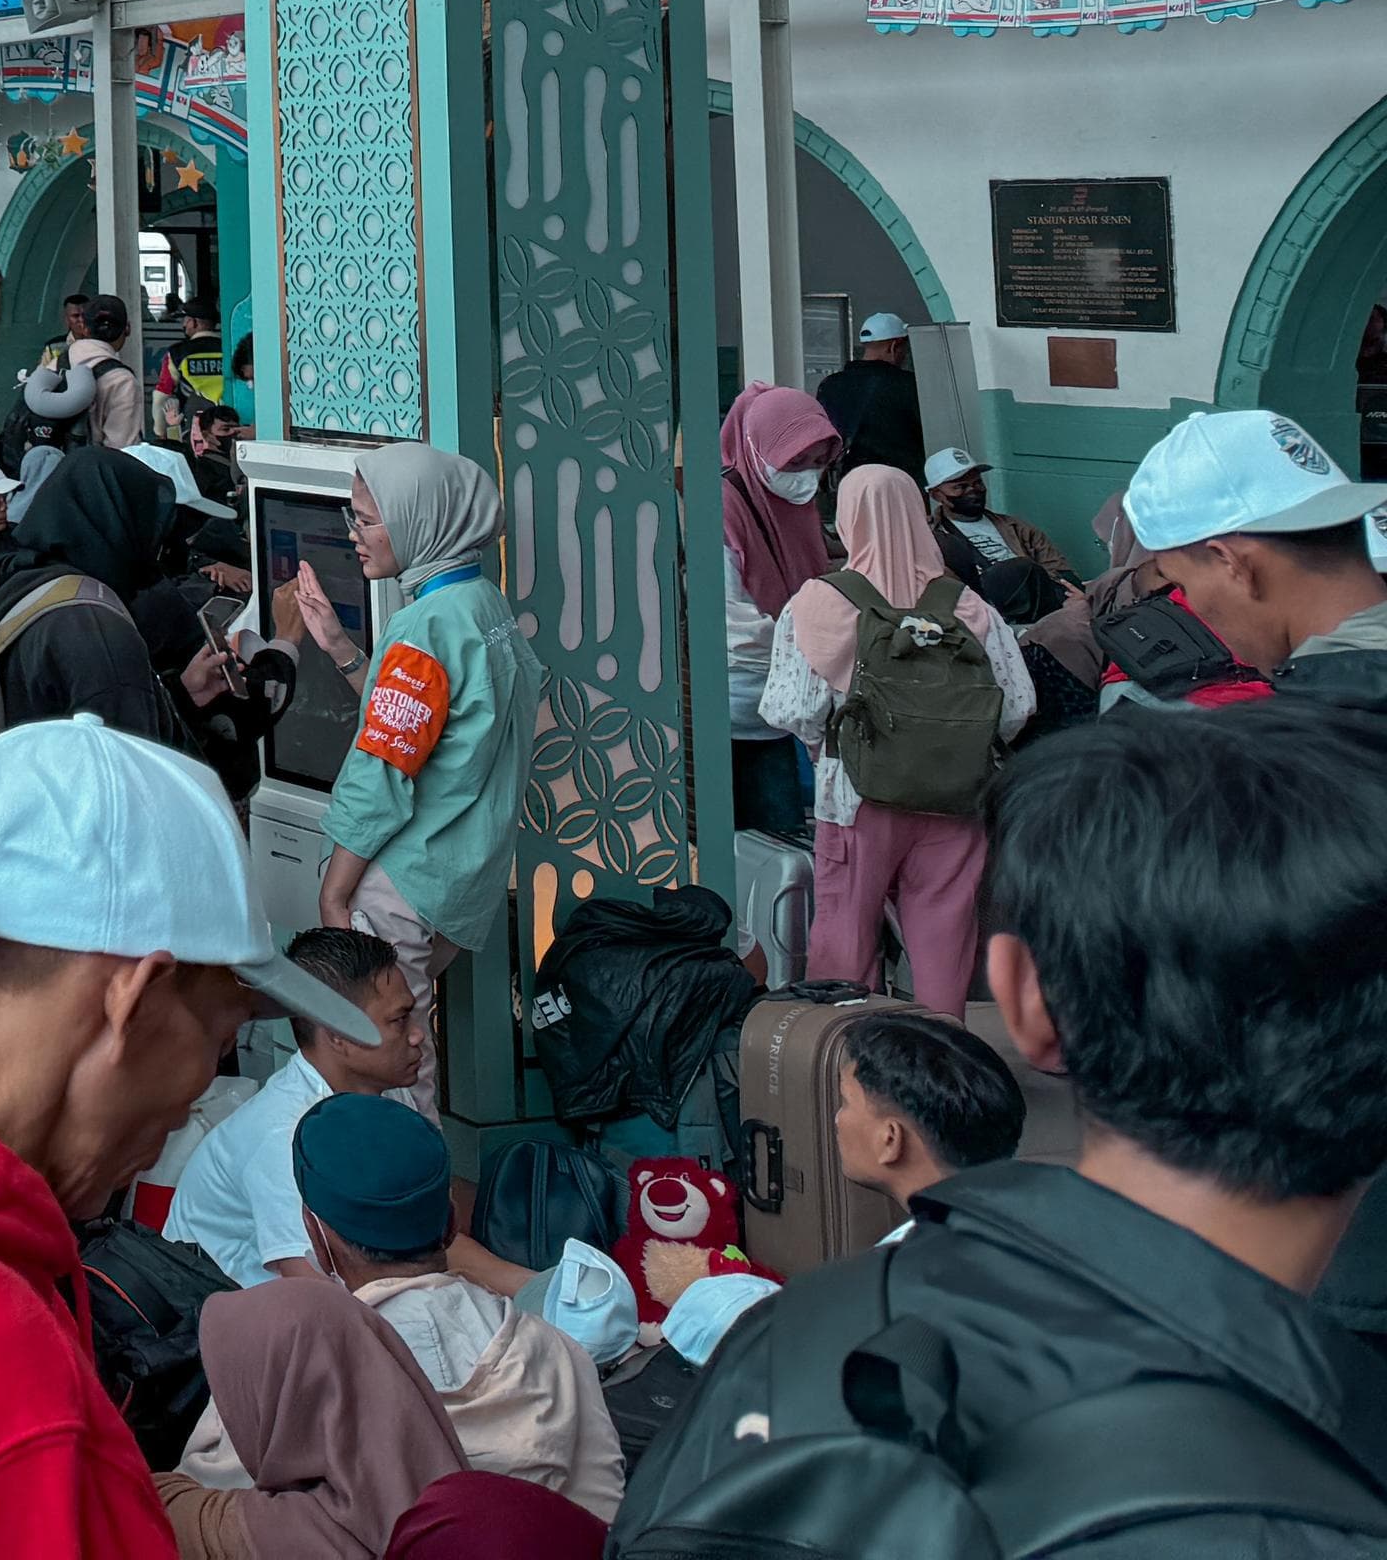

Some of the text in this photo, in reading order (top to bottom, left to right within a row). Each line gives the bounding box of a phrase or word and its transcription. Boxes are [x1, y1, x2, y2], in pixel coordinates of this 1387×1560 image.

[188, 359, 224, 376] SATPA
[370, 685, 432, 724] CUSTOMER
[370, 701, 421, 735] SERVICE
[389, 735, 418, 755] Saya
[767, 1034, 784, 1097] PRINCE
